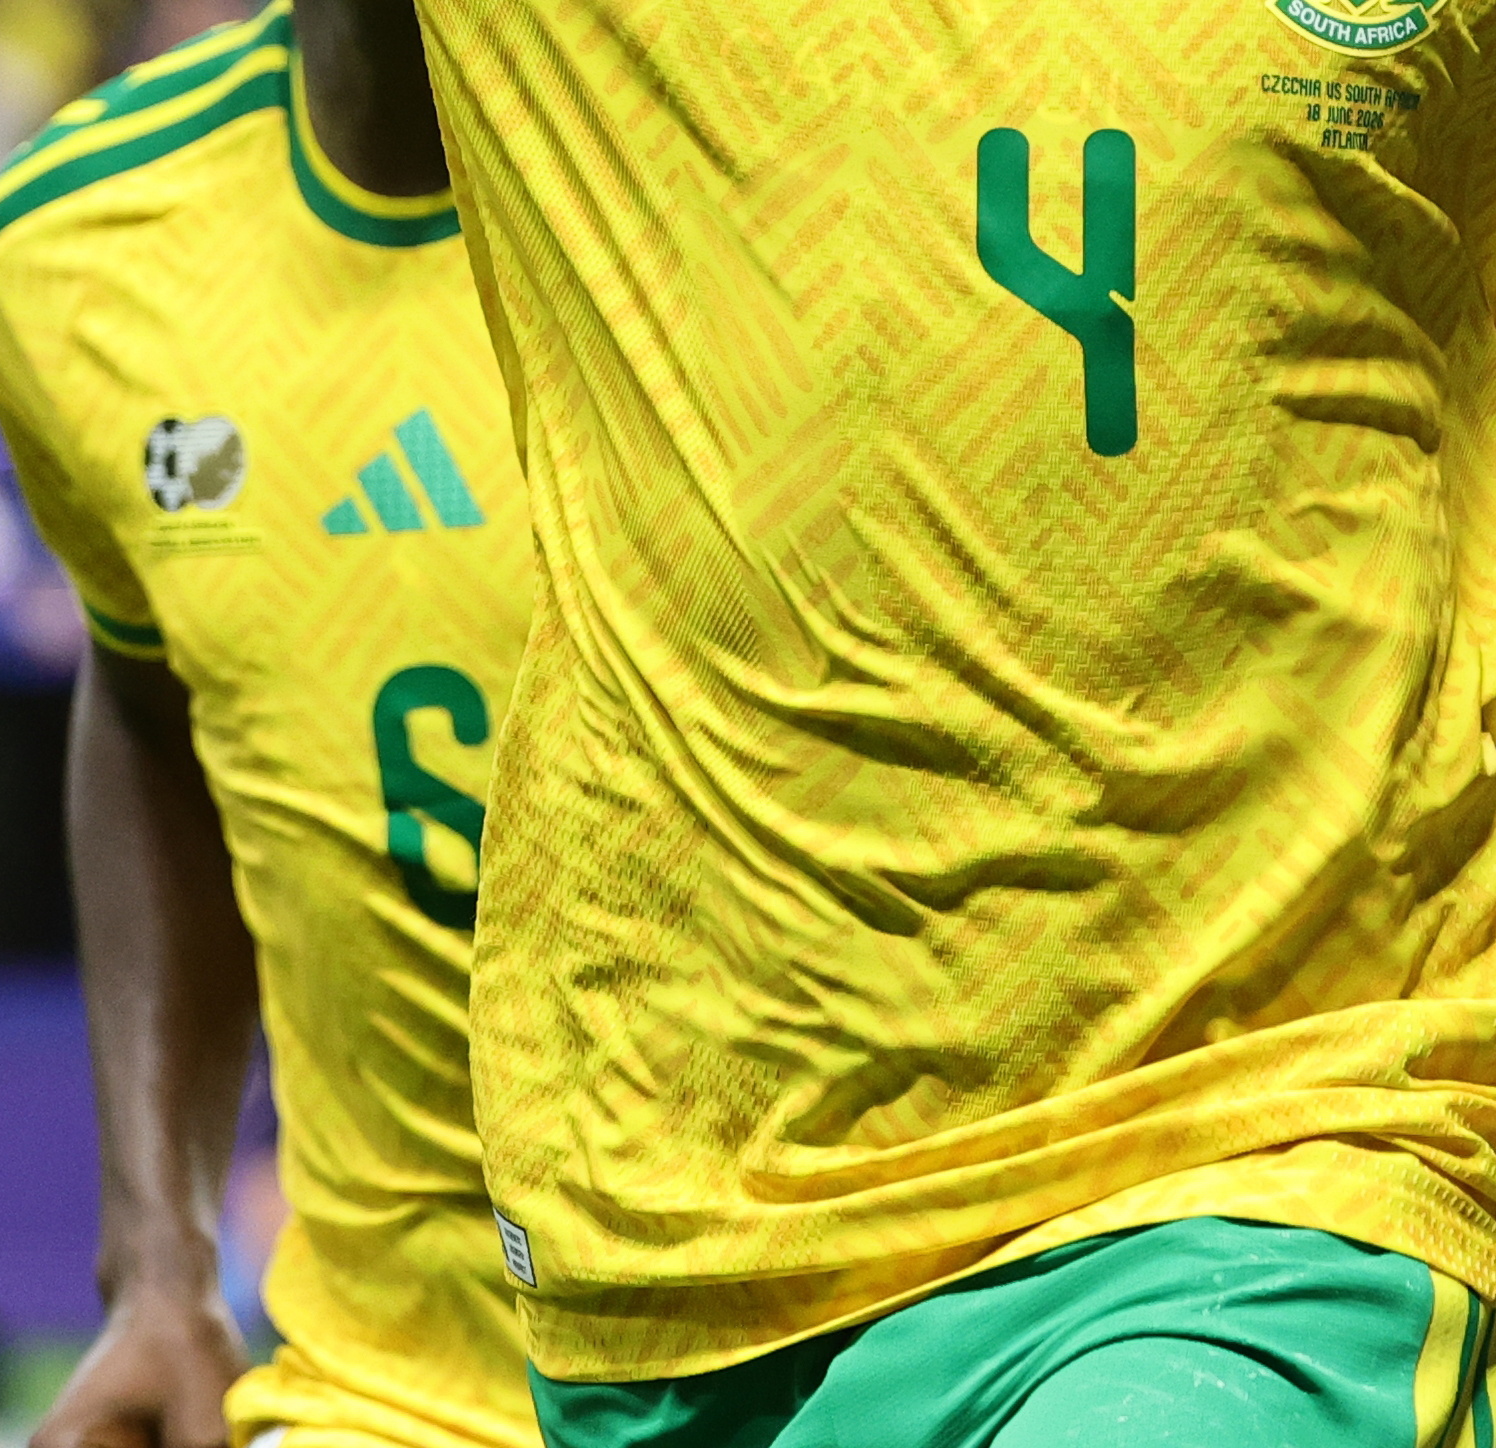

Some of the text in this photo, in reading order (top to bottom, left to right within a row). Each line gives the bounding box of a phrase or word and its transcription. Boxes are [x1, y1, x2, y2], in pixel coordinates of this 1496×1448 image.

[1288, 0, 1418, 44] SOUTH AFRICA
[1261, 74, 1321, 97] CZECHIA
[1345, 84, 1382, 106] SOUTH
[1307, 103, 1384, 129] 18 JUNE 2026
[976, 127, 1138, 457] 4
[373, 664, 490, 931] 6
